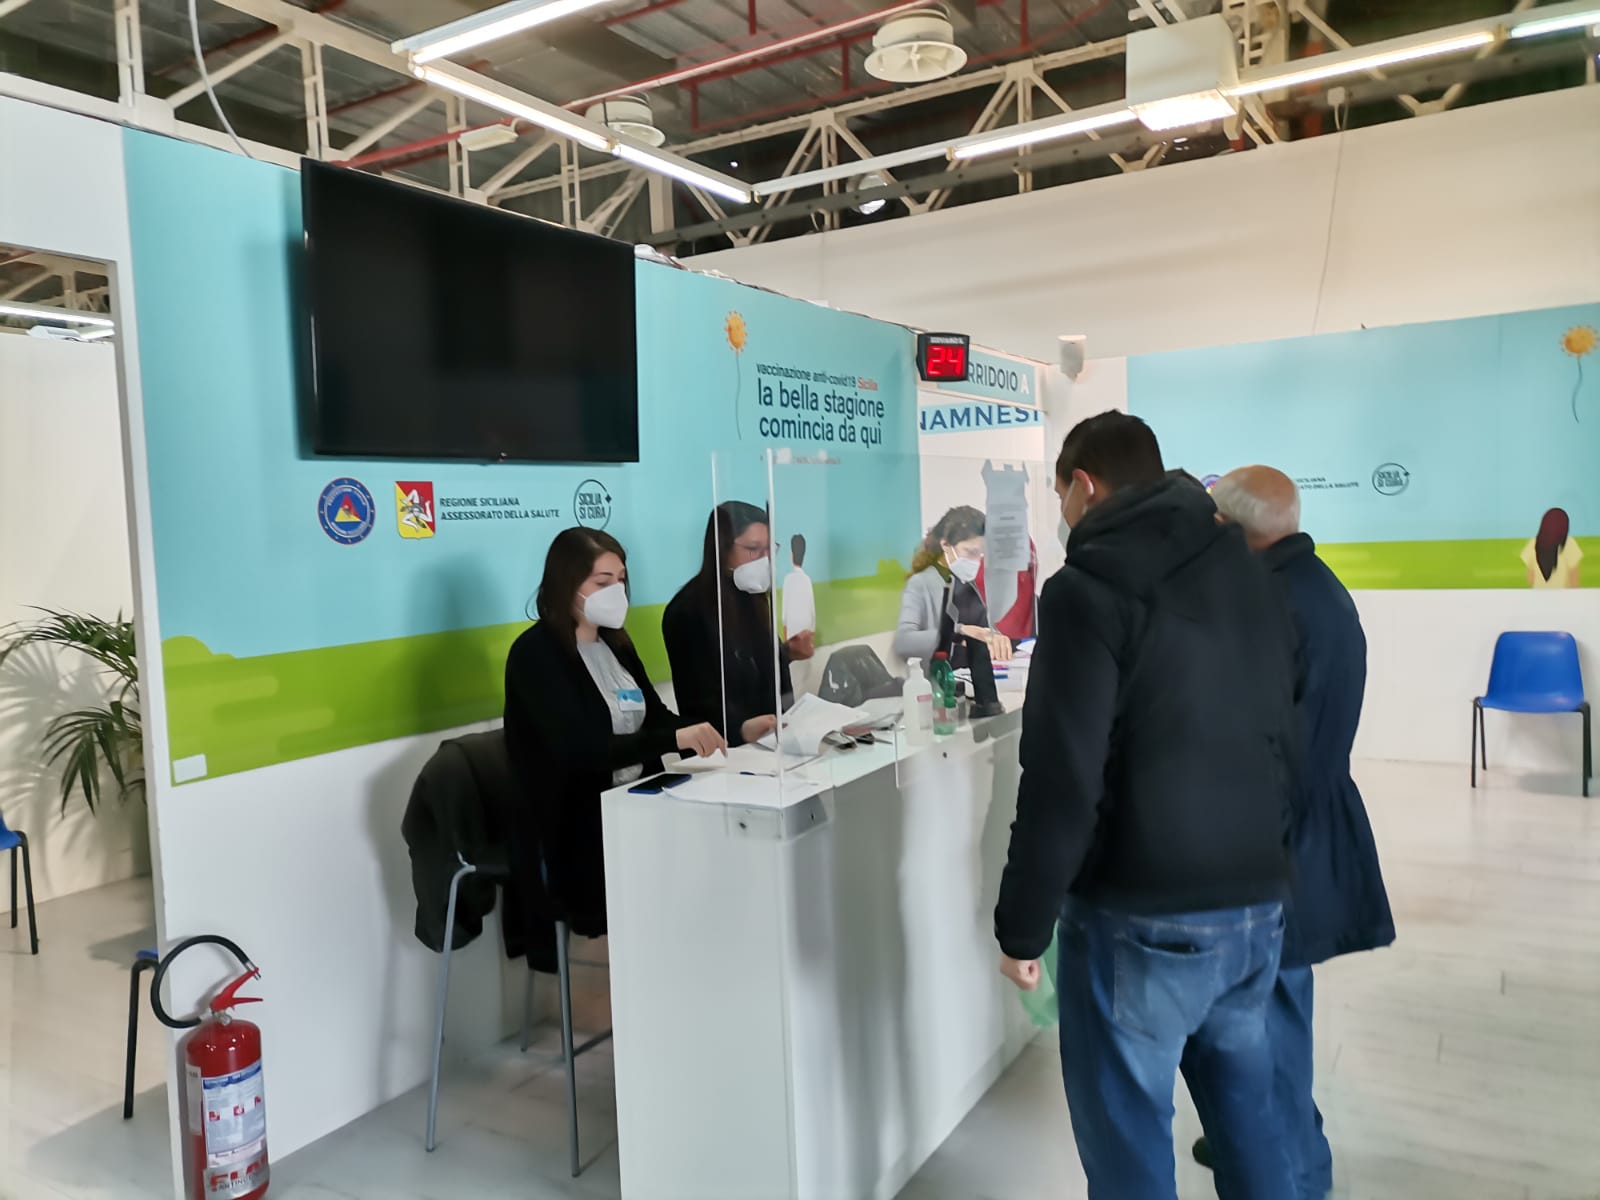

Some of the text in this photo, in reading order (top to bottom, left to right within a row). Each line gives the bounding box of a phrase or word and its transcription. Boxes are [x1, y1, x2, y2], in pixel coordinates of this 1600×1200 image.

[756, 362, 811, 382] vaccinazione
[927, 345, 964, 376] 24
[758, 377, 885, 420] la bella stagione
[759, 413, 882, 449] comincia da qui
[439, 497, 520, 507] REGIONE SICILIANA
[441, 509, 560, 521] ASSESSORATO DELLA SALUTE
